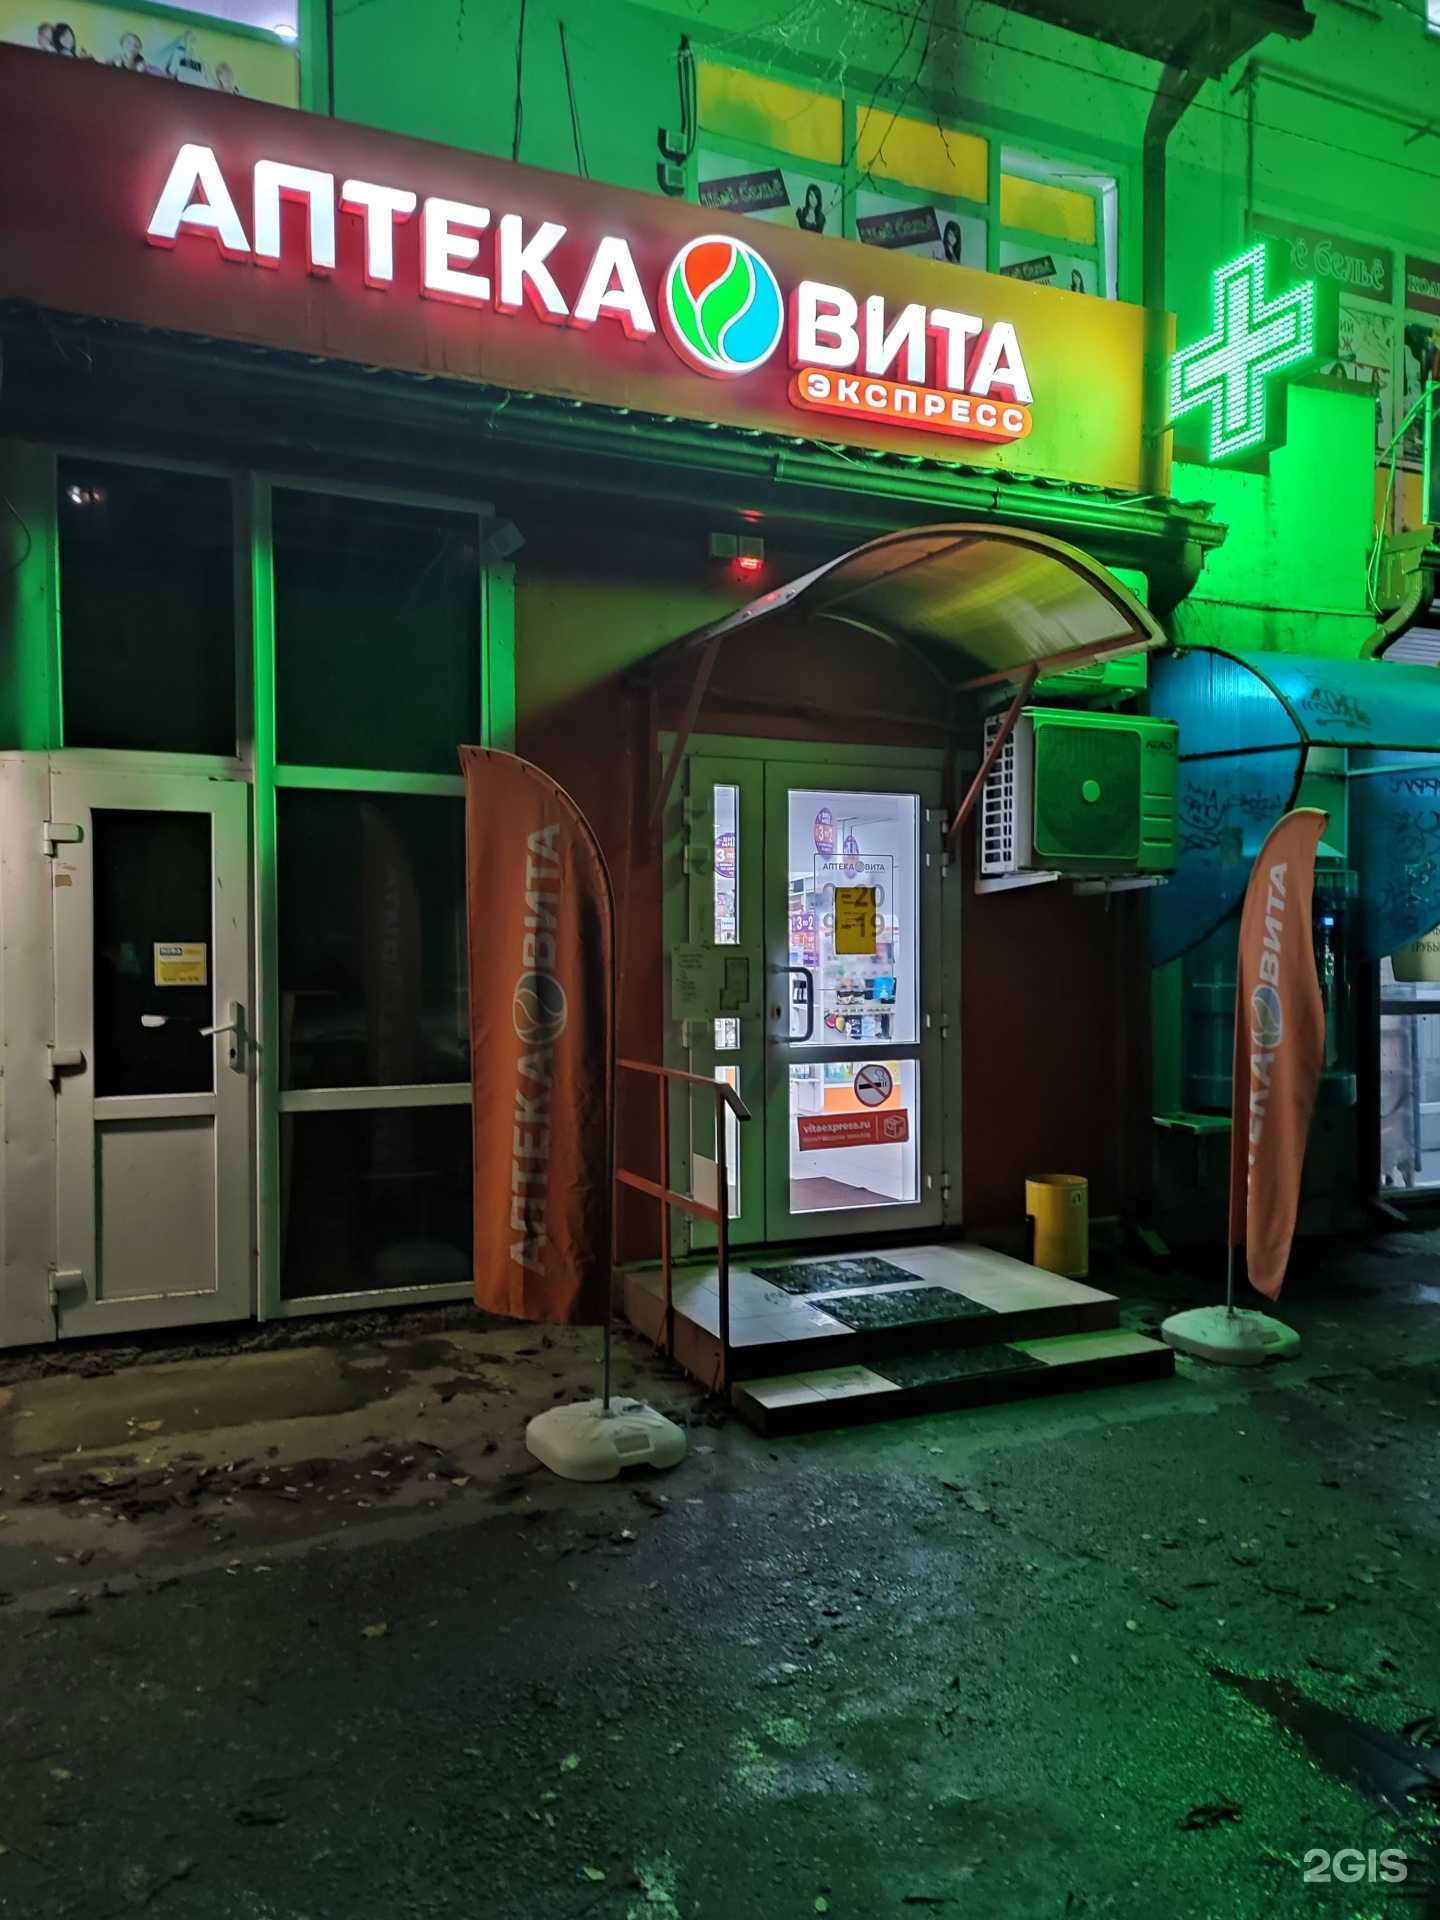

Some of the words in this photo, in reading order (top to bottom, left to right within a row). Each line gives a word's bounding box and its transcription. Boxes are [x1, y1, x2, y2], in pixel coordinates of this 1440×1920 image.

[147, 143, 656, 341] АПТЕКА
[797, 280, 1033, 403] ВИТА
[807, 373, 1024, 432] ЭКСПРЕСС
[523, 823, 560, 968] ВИТА
[822, 863, 855, 872] АПТЕКА
[865, 864, 885, 872] ВИТА
[1260, 862, 1288, 987] ВИТА
[510, 1047, 554, 1277] АПТЕКА
